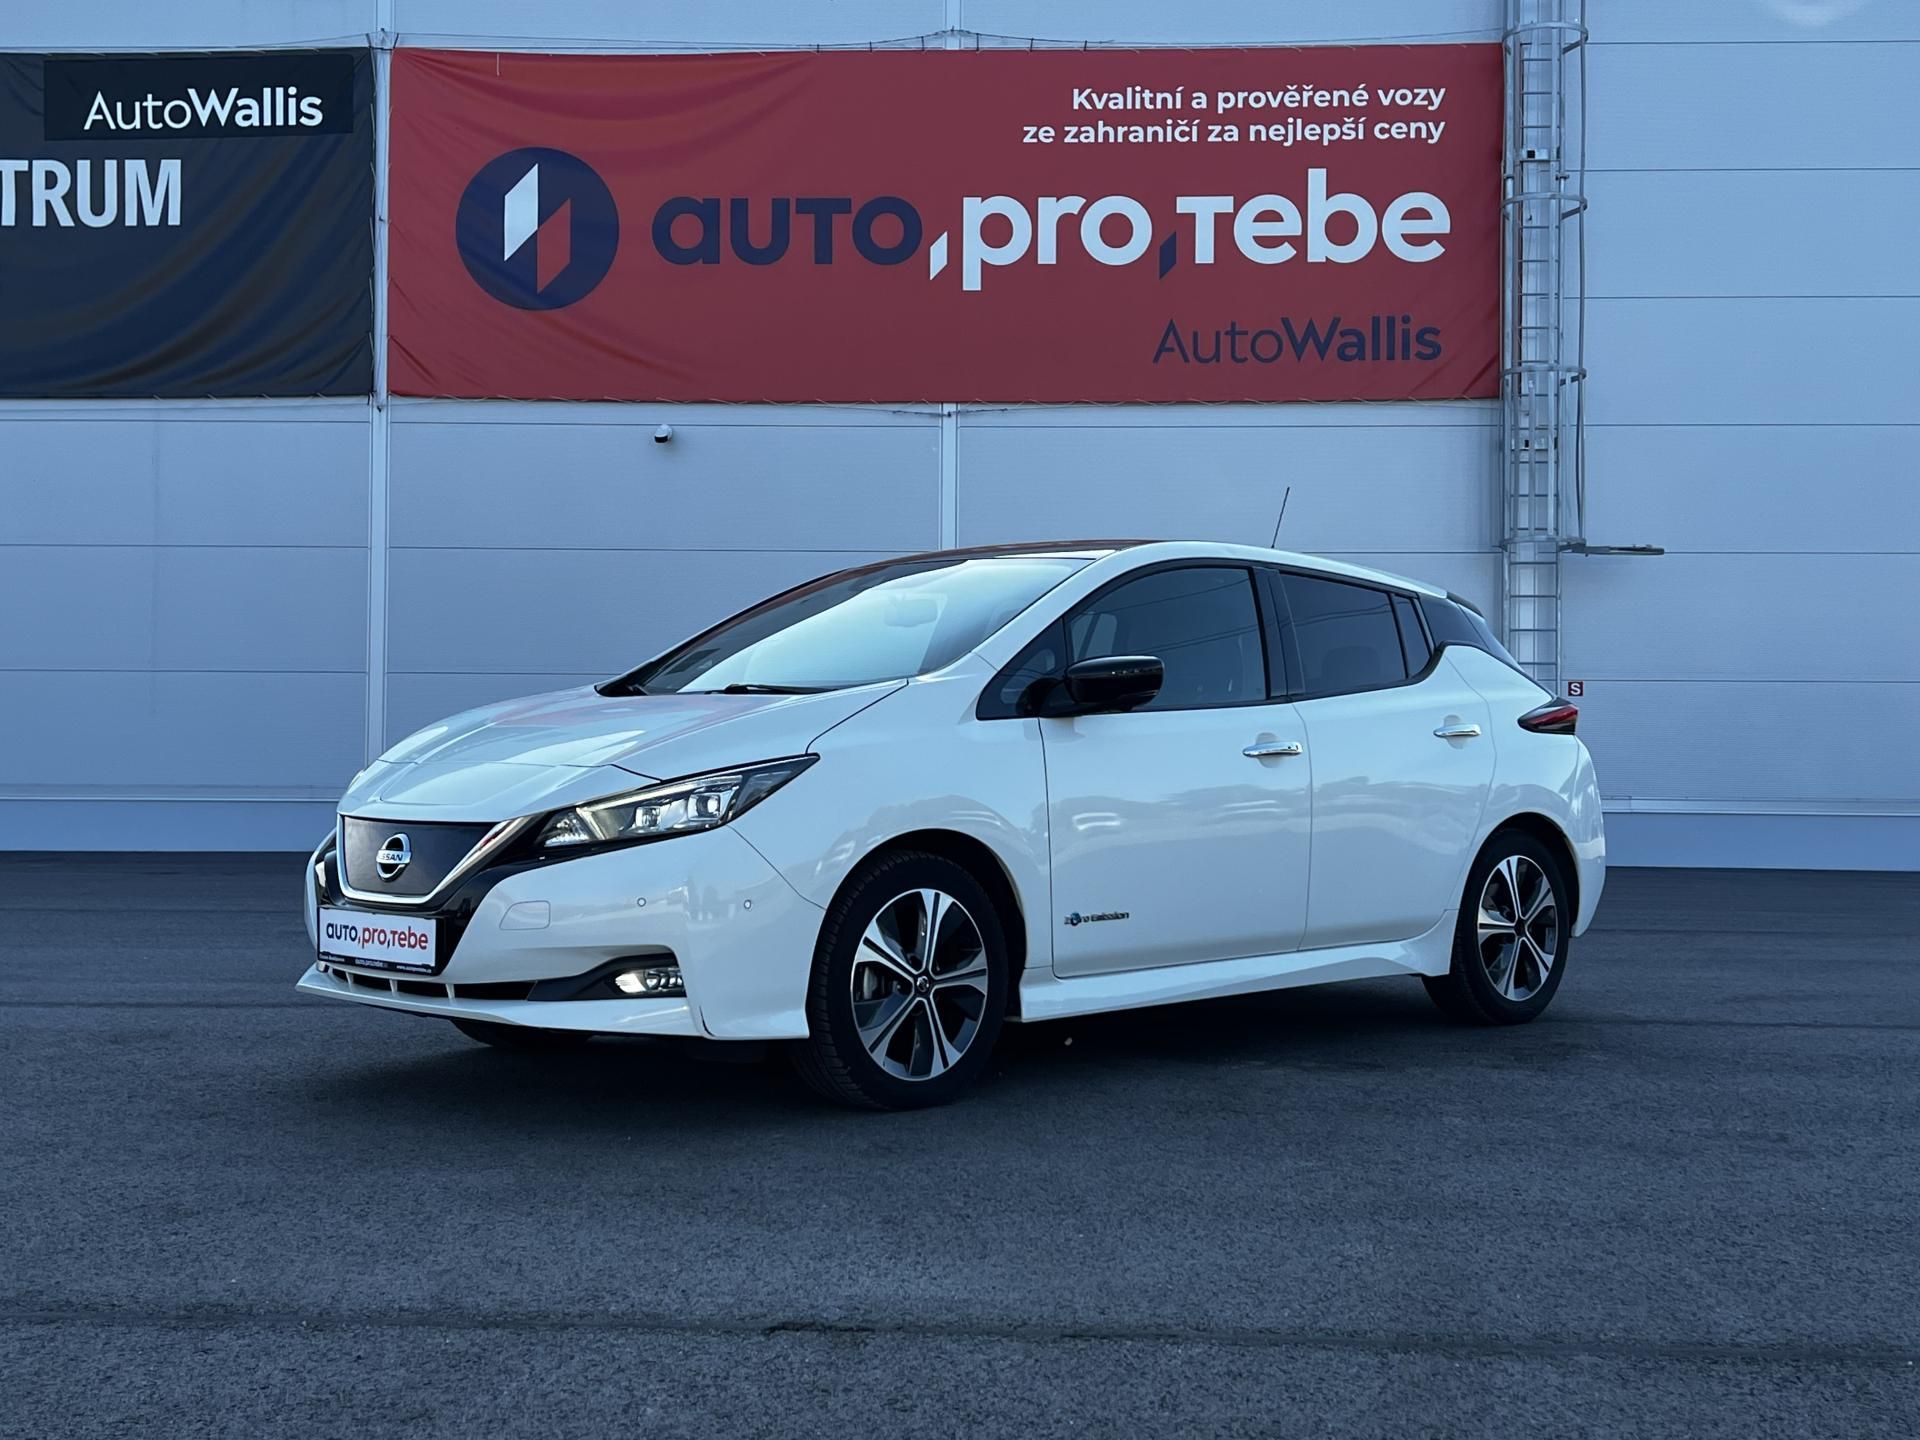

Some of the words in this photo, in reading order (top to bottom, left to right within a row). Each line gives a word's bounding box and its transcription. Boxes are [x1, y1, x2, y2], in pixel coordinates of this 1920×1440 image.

[83, 86, 324, 131] AutoWallis
[1072, 86, 1184, 110] Kvalitní
[1191, 93, 1208, 109] a
[1217, 84, 1369, 114] prověřené
[1377, 87, 1446, 110] vozy
[1023, 126, 1056, 144] ze
[1064, 118, 1199, 143] zahraničí
[1207, 125, 1239, 142] za
[1249, 118, 1366, 147] nejlepší
[1373, 121, 1446, 143] ceny
[0, 158, 182, 228] TRUM
[1152, 314, 1443, 364] AutoWallis
[1570, 682, 1581, 695] S
